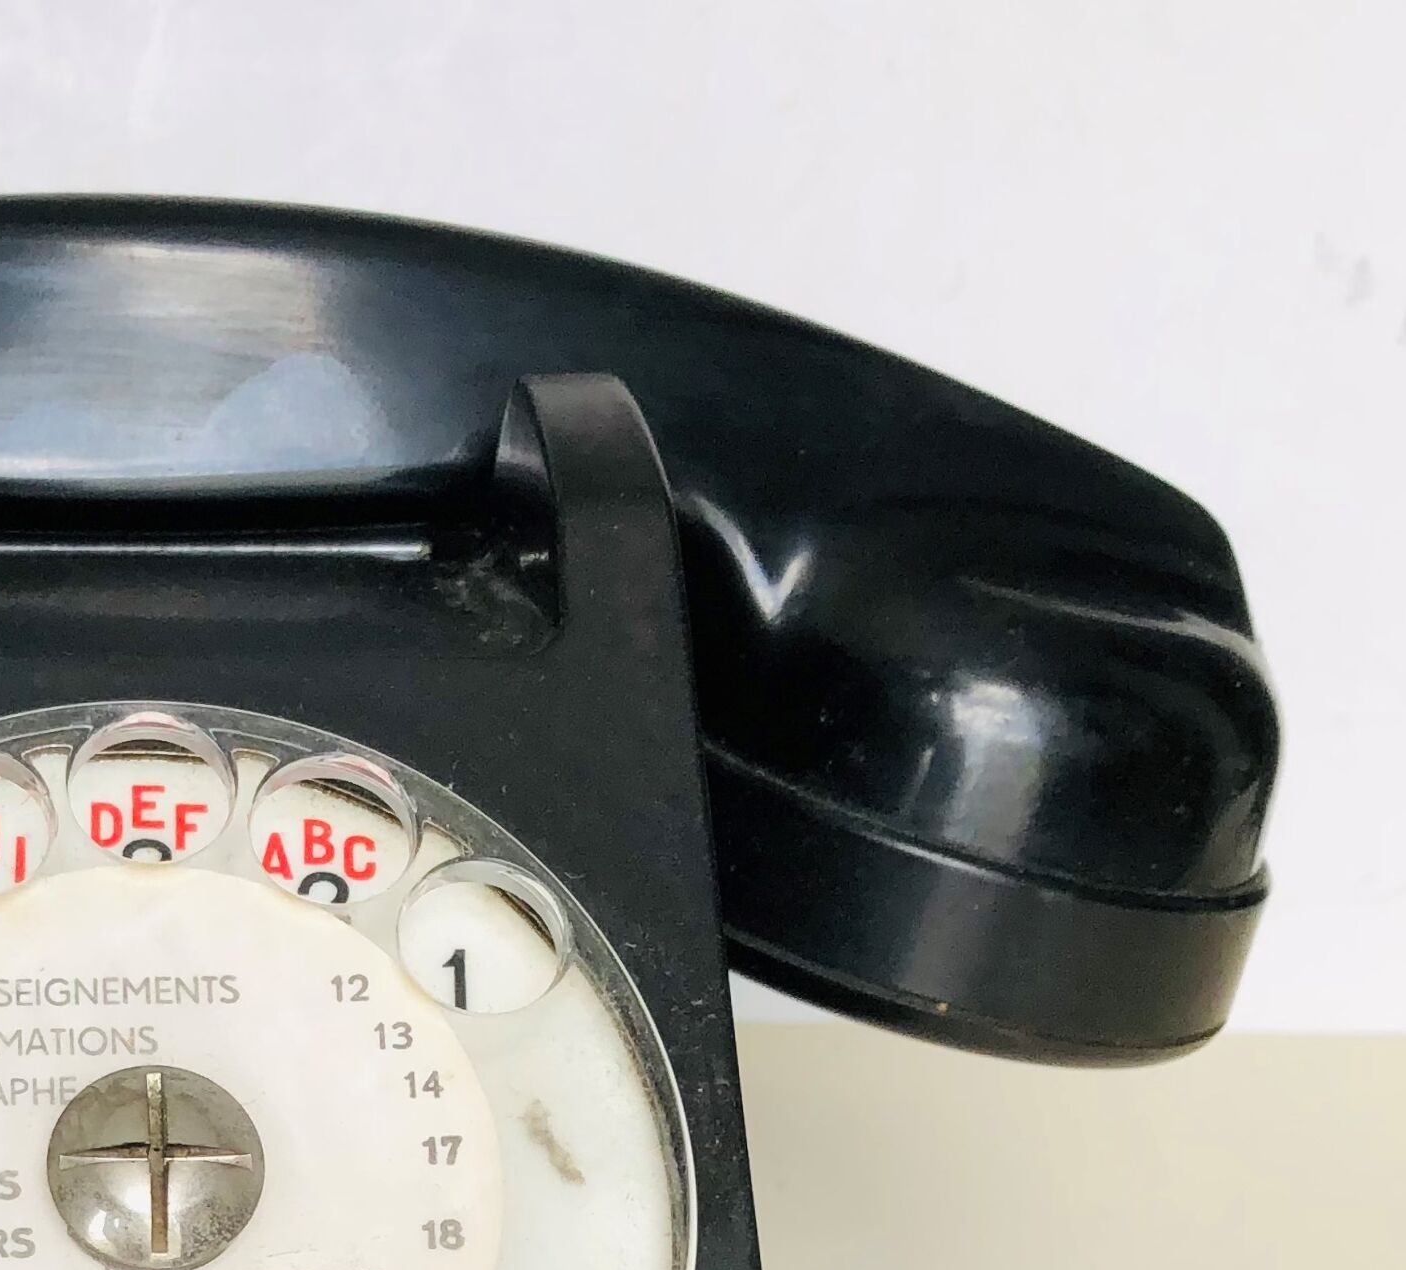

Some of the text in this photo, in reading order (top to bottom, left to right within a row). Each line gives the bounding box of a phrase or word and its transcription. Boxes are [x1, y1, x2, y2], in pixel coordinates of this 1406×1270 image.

[91, 785, 208, 850] DEF
[262, 819, 377, 881] ABC
[331, 974, 370, 1003] 12
[442, 949, 467, 1010] 1
[373, 1022, 414, 1050] 13
[403, 1071, 444, 1100] 14
[422, 1136, 463, 1167] 17
[422, 1219, 466, 1251] 18
